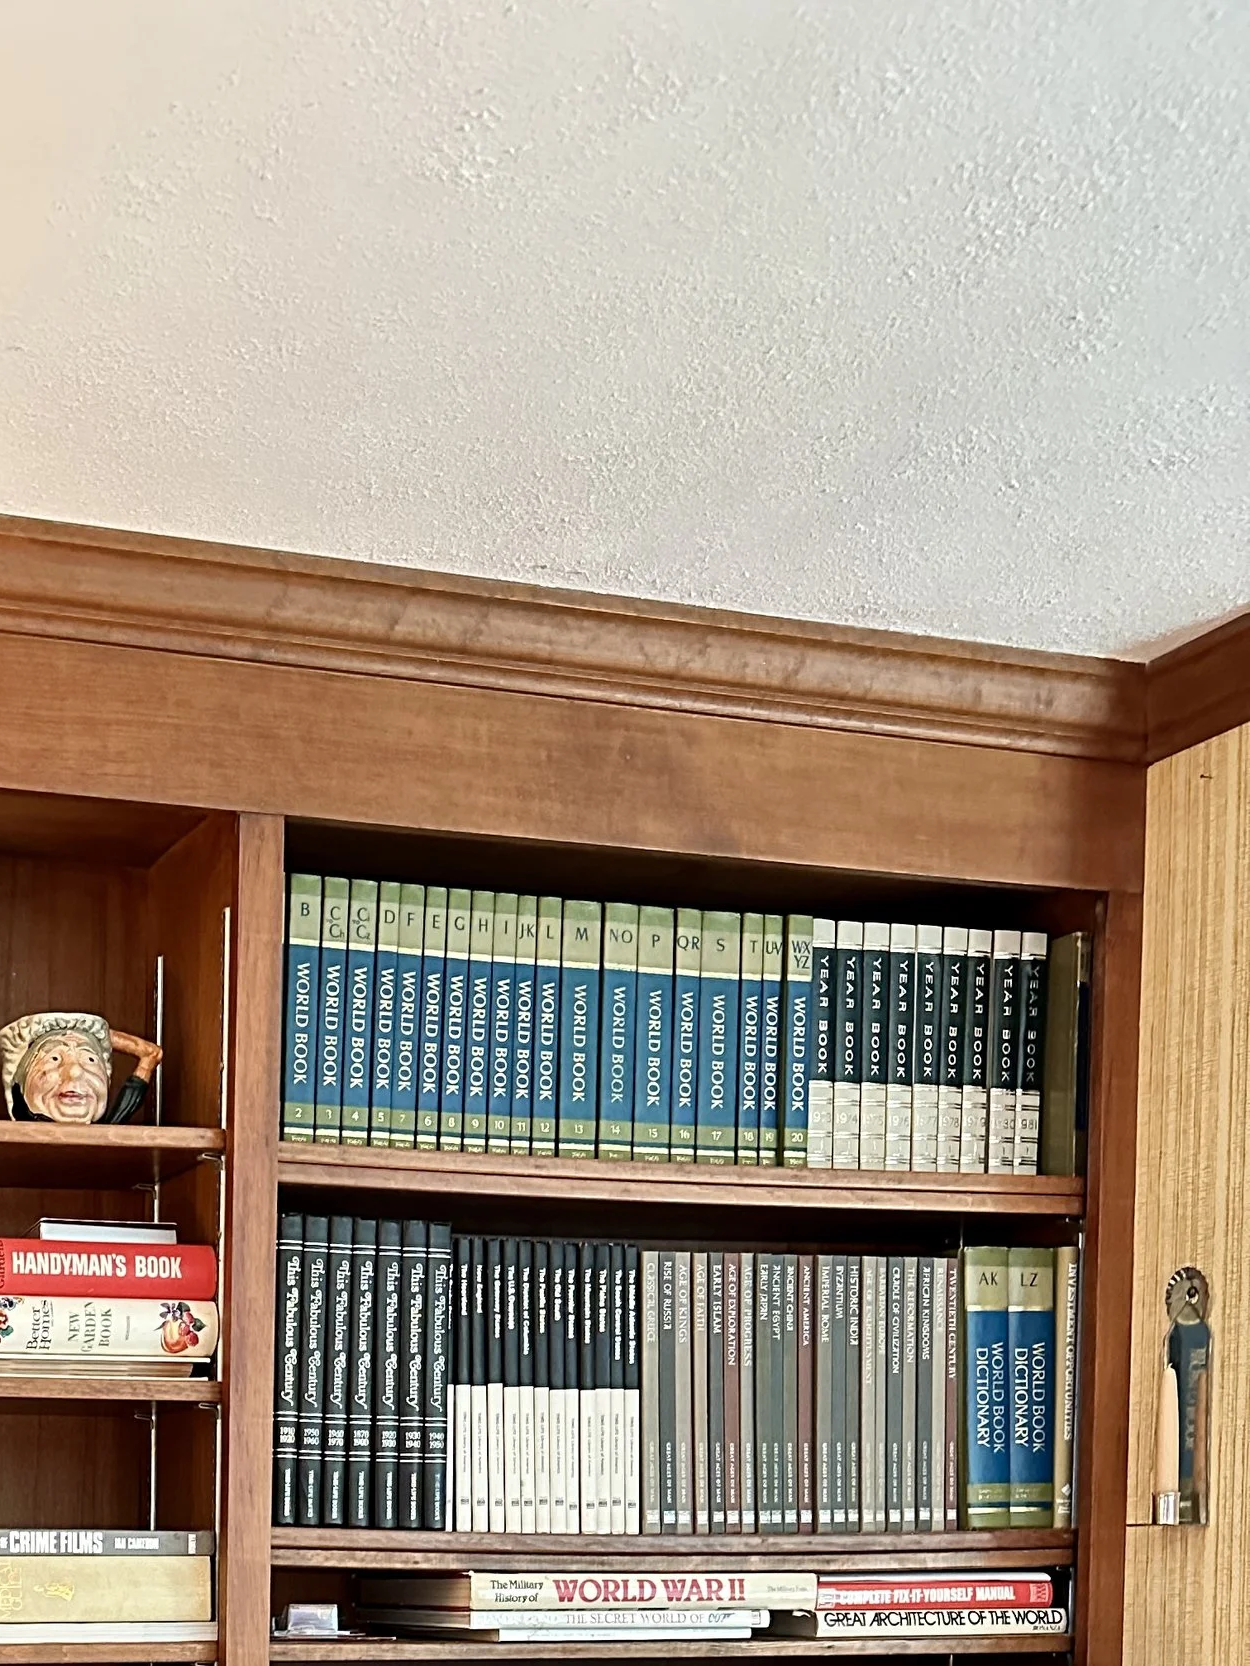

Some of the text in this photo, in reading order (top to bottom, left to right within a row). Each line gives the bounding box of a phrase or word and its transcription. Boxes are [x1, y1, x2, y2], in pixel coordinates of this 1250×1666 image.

[301, 903, 310, 917] B
[385, 910, 396, 924] D
[432, 914, 440, 929] E
[454, 916, 465, 931] G
[478, 919, 488, 932] H
[519, 923, 535, 939] JK
[575, 928, 588, 941] M
[652, 934, 660, 948] P
[716, 939, 725, 952] S
[766, 942, 782, 955] UV
[791, 941, 810, 954] WX
[794, 956, 810, 968] YZ
[817, 954, 830, 1074] YEAR BOOK
[293, 962, 310, 1085] WORLD BOOK
[446, 975, 464, 1096] WORLD BOOK
[572, 985, 587, 1103] WORLD BOOK
[646, 990, 662, 1107] WORLD BOOK
[791, 997, 806, 1112] WORLD BOOK
[295, 1108, 302, 1118] 2
[472, 1119, 478, 1129] 9
[574, 1124, 584, 1134] 13
[680, 1129, 690, 1140] 16
[791, 1133, 804, 1144] 20
[12, 1252, 182, 1279] HANDYMAN'S BOOK
[979, 1272, 998, 1286] AK
[1020, 1272, 1038, 1287] LZ
[713, 1264, 722, 1334] EARLY ISLAM
[850, 1266, 858, 1345] HISTORIC INDIA
[26, 1306, 41, 1350] Better
[68, 1311, 80, 1342] NEW
[81, 1302, 97, 1352] GARDEN
[99, 1308, 112, 1347] BOOK
[281, 1256, 300, 1407] This Fabulous Century
[976, 1348, 990, 1448] DICTIONARY
[992, 1342, 1006, 1454] WORLD BOOK
[9, 1531, 58, 1554] CRIME
[59, 1531, 103, 1554] FILMS
[490, 1580, 544, 1592] The Military
[552, 1578, 746, 1603] WORLD WAR II
[494, 1592, 538, 1604] History of
[894, 1586, 974, 1603] FIX-IT-YOURSELF
[976, 1586, 1016, 1601] MANUAL
[566, 1614, 587, 1624] THE
[590, 1613, 638, 1624] SECRET
[641, 1613, 687, 1624] WORLD
[690, 1613, 704, 1624] OF
[824, 1610, 1062, 1627] GREAT ARCHITECTURE OF THE WORLD
